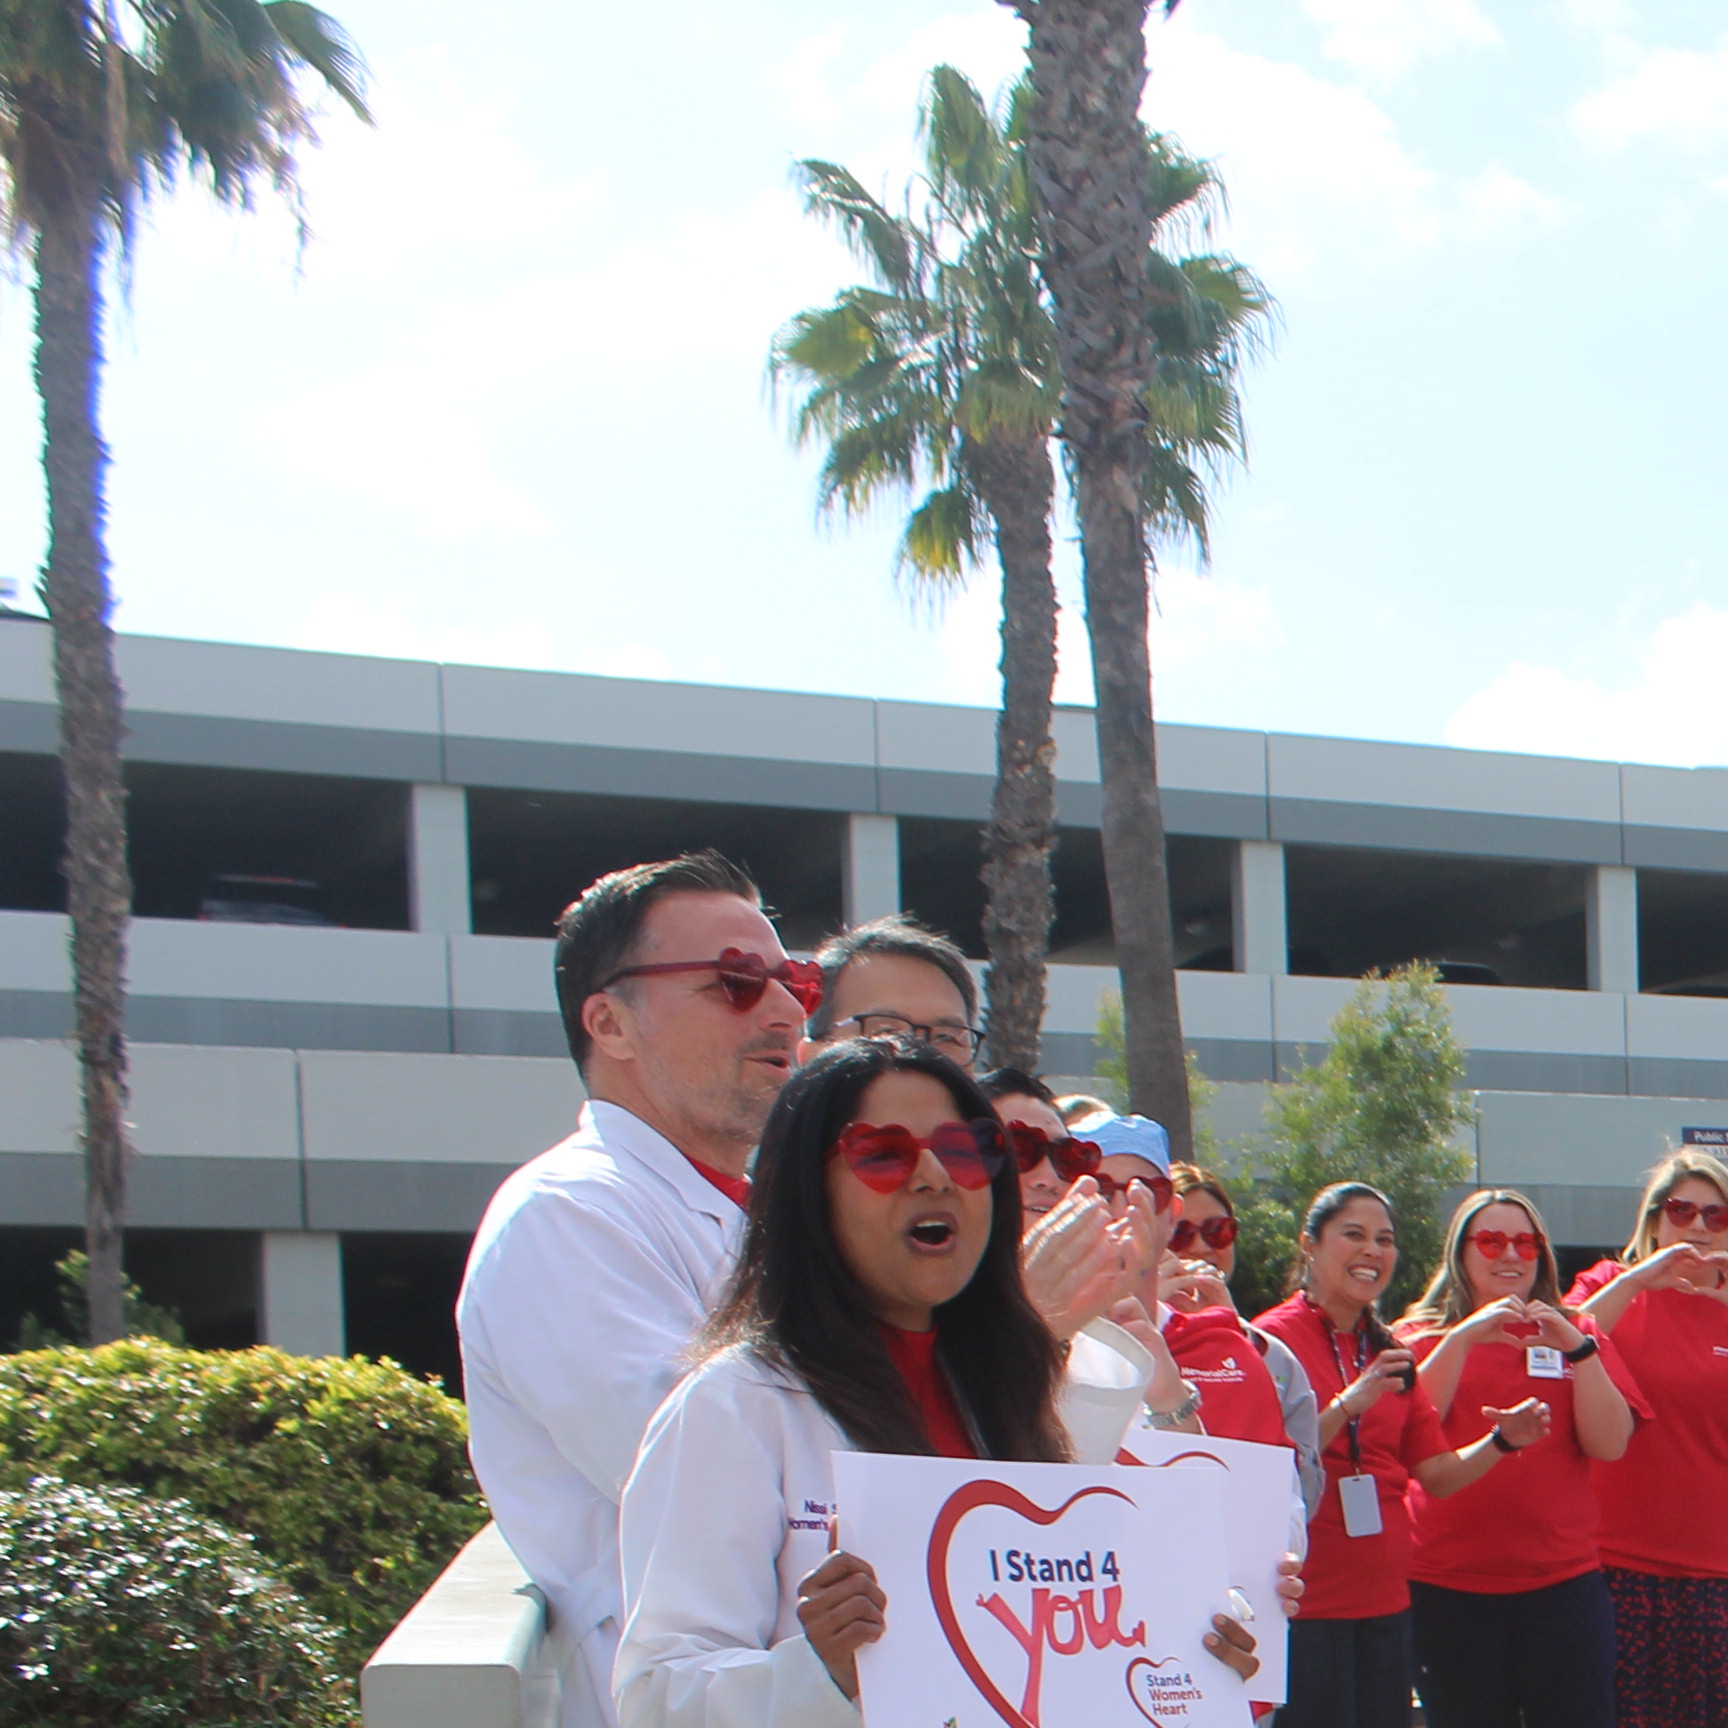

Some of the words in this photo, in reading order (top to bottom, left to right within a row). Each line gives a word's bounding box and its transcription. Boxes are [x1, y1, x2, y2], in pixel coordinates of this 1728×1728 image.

[989, 1549, 1001, 1582] I
[1006, 1549, 1094, 1582] Stand
[1101, 1551, 1121, 1582] 4
[1146, 1674, 1182, 1687] Stand
[1184, 1673, 1193, 1685] 4
[1149, 1687, 1203, 1701] Women's
[1153, 1703, 1188, 1716] Heart
